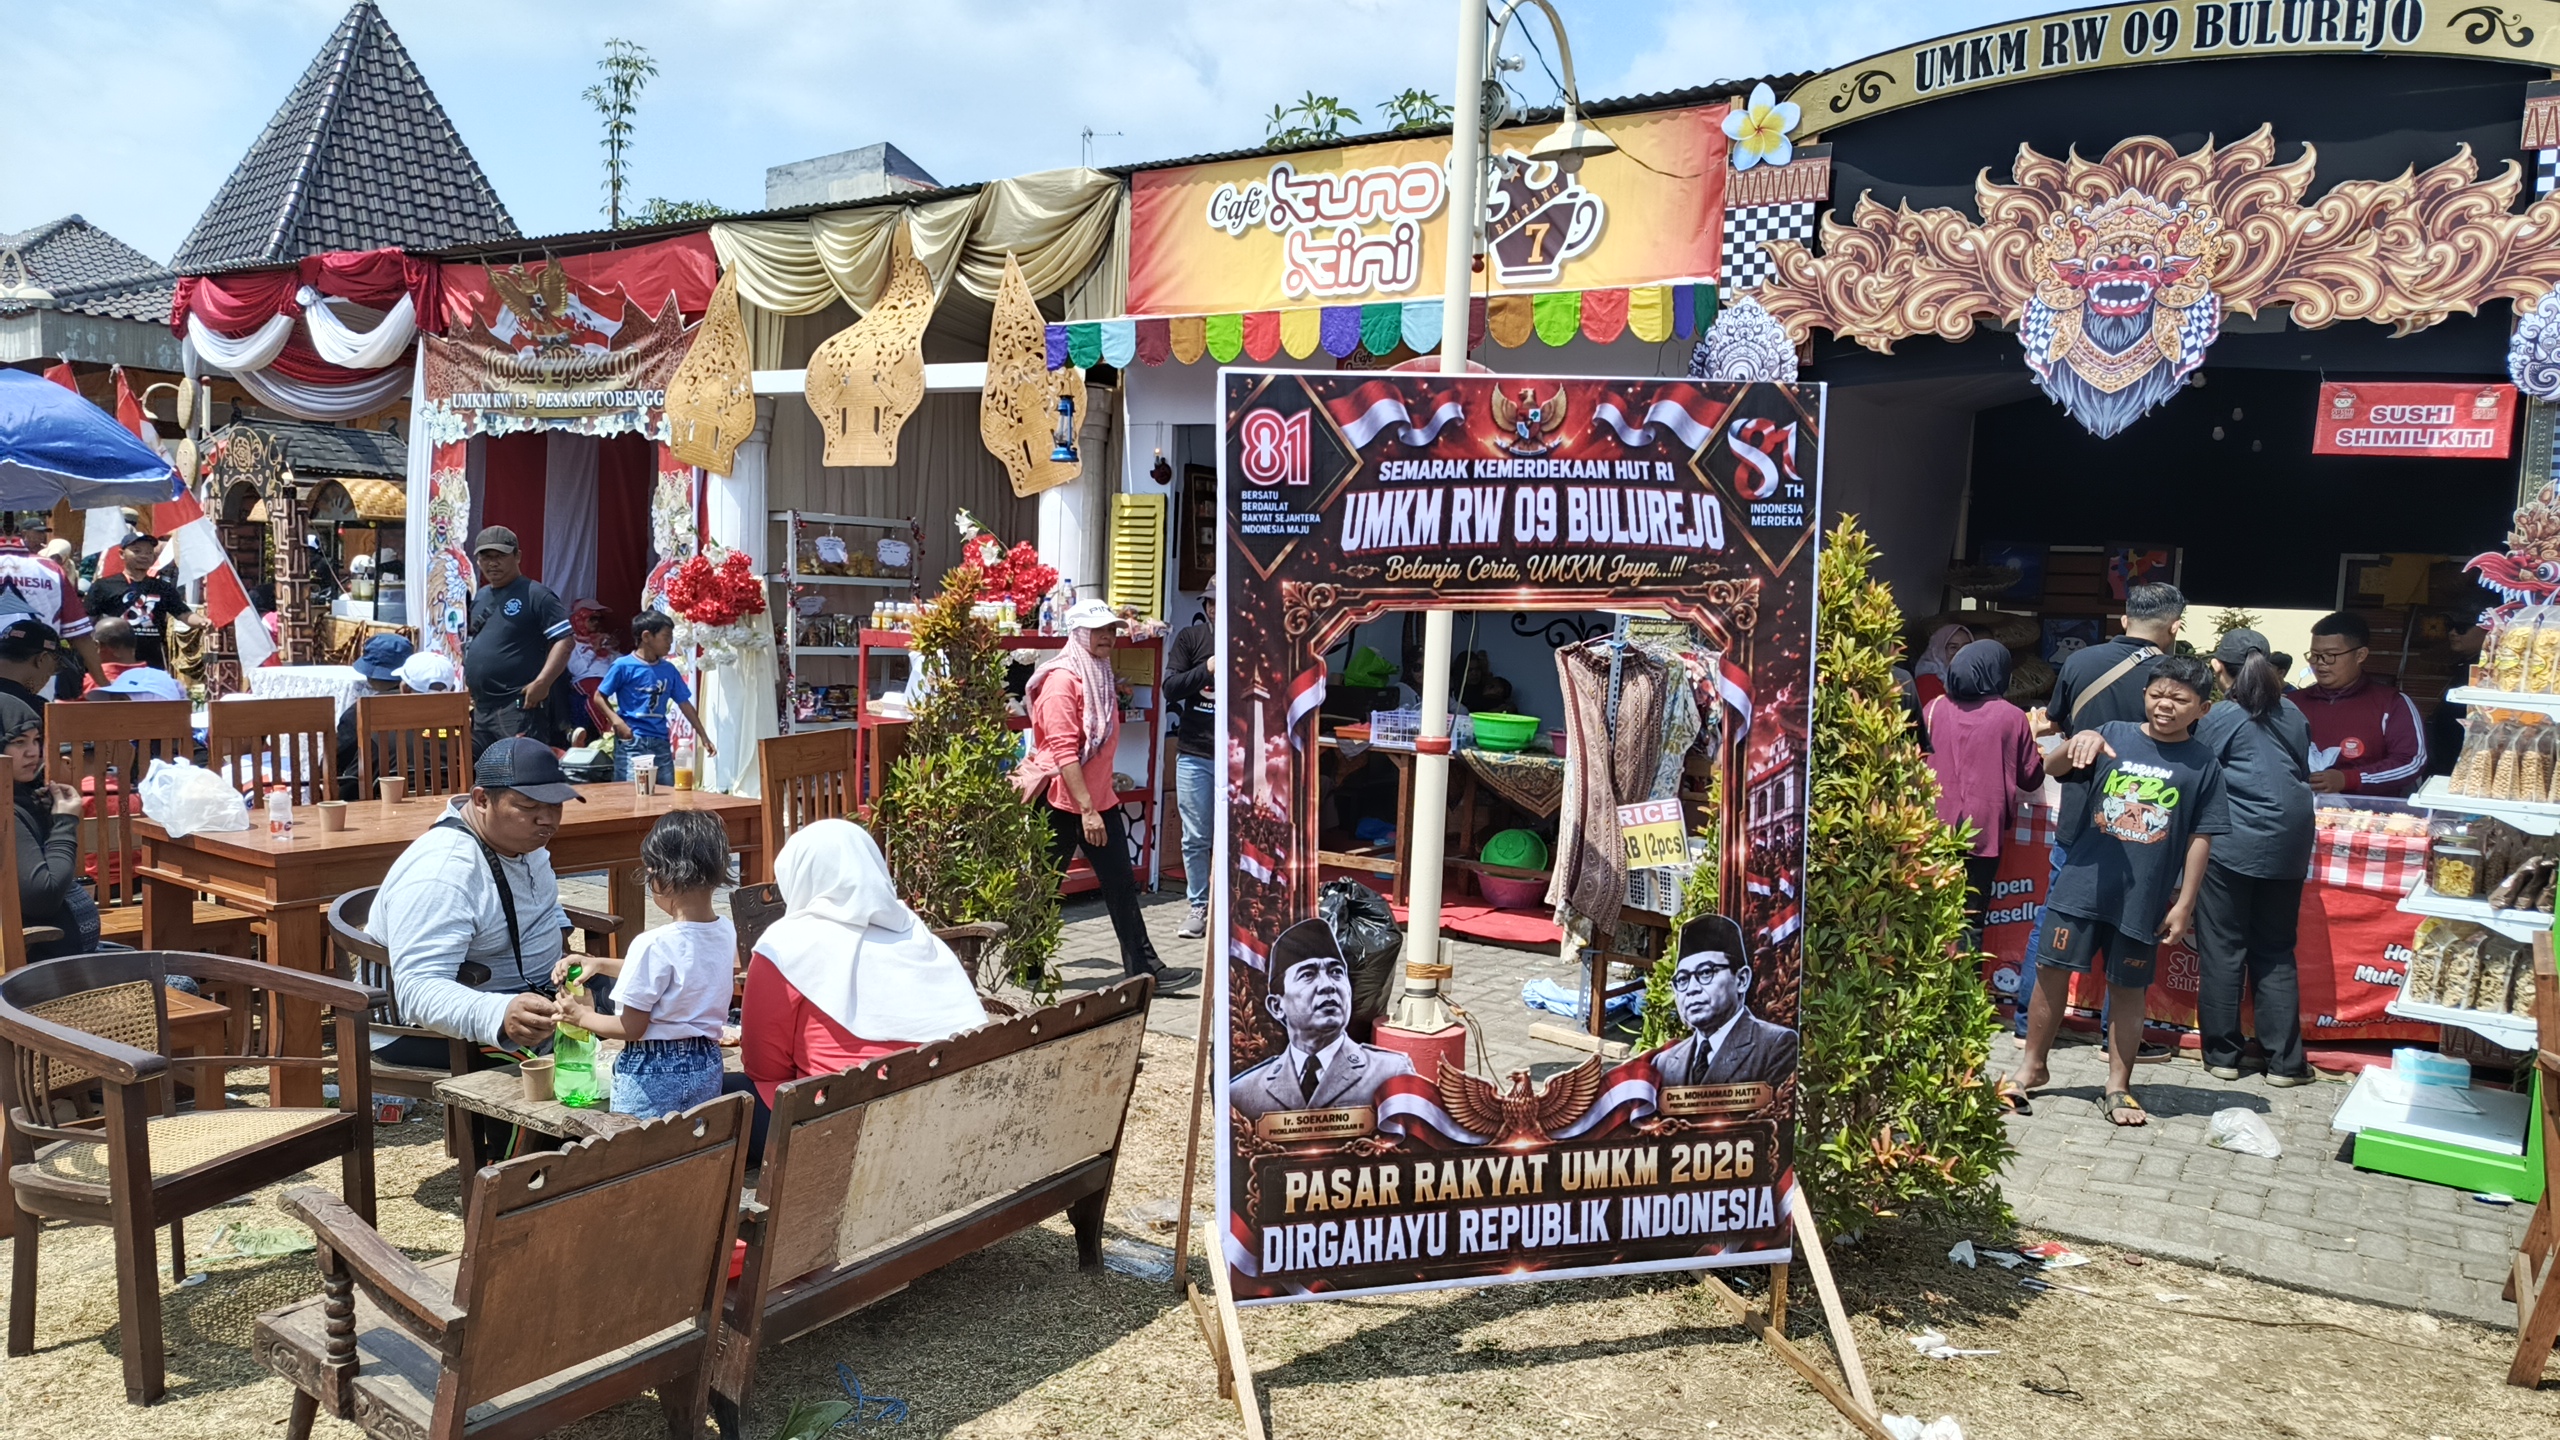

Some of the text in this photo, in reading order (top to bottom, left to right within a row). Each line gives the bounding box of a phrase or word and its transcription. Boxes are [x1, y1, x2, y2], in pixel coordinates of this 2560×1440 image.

[1915, 0, 2423, 92] UMKM RW 09 BULUREJO
[1210, 187, 1262, 229] Café
[1495, 183, 1560, 235] BINTANG
[1525, 223, 1550, 263] 7
[452, 393, 492, 409] UMKM
[494, 393, 510, 408] RW
[515, 393, 528, 409] 13
[536, 391, 569, 408] DESA
[571, 389, 665, 408] SAPTORENGG
[2370, 405, 2455, 424] SUSHI
[1241, 408, 1312, 486] 81
[2335, 428, 2495, 448] SHIMILIKITI
[1379, 459, 1675, 481] SEMARAK KEMERDEKAAN HUT RI
[1241, 490, 1279, 500] BERSATU
[1785, 484, 1804, 498] TH
[1241, 502, 1289, 511] BERDAULAT
[1750, 504, 1804, 514] INDONESIA
[1241, 513, 1321, 523] RAKYAT SEJAHTERA
[1341, 486, 1725, 552] UMKM RW 09 BULUREJO
[1751, 516, 1803, 526] MERDEKA
[1241, 525, 1309, 534] INDONESIA MAJU
[1385, 555, 1462, 588] Belanja
[1467, 555, 1521, 582] Ceria,
[1527, 555, 1603, 583] UMKM
[2103, 769, 2179, 808] KEBO
[1617, 802, 1680, 827] RICE
[2105, 823, 2149, 841] SAMAWA
[1644, 828, 1687, 863] (2pcs)
[1984, 902, 2042, 925] esell
[2053, 927, 2070, 951] 13
[2384, 943, 2412, 962] Ha
[2168, 951, 2200, 979] SU
[2354, 964, 2403, 986] Mula
[1684, 1089, 1733, 1100] MOHAMMAD
[1735, 1087, 1761, 1097] HATTA
[1283, 1113, 1350, 1126] Ir. SOEKARNO
[1285, 1139, 1755, 1214] PASAR RAKYAT UMKM 2026
[1262, 1185, 1776, 1273] DIRGAHAYU REPUBLIK INDONESIA
